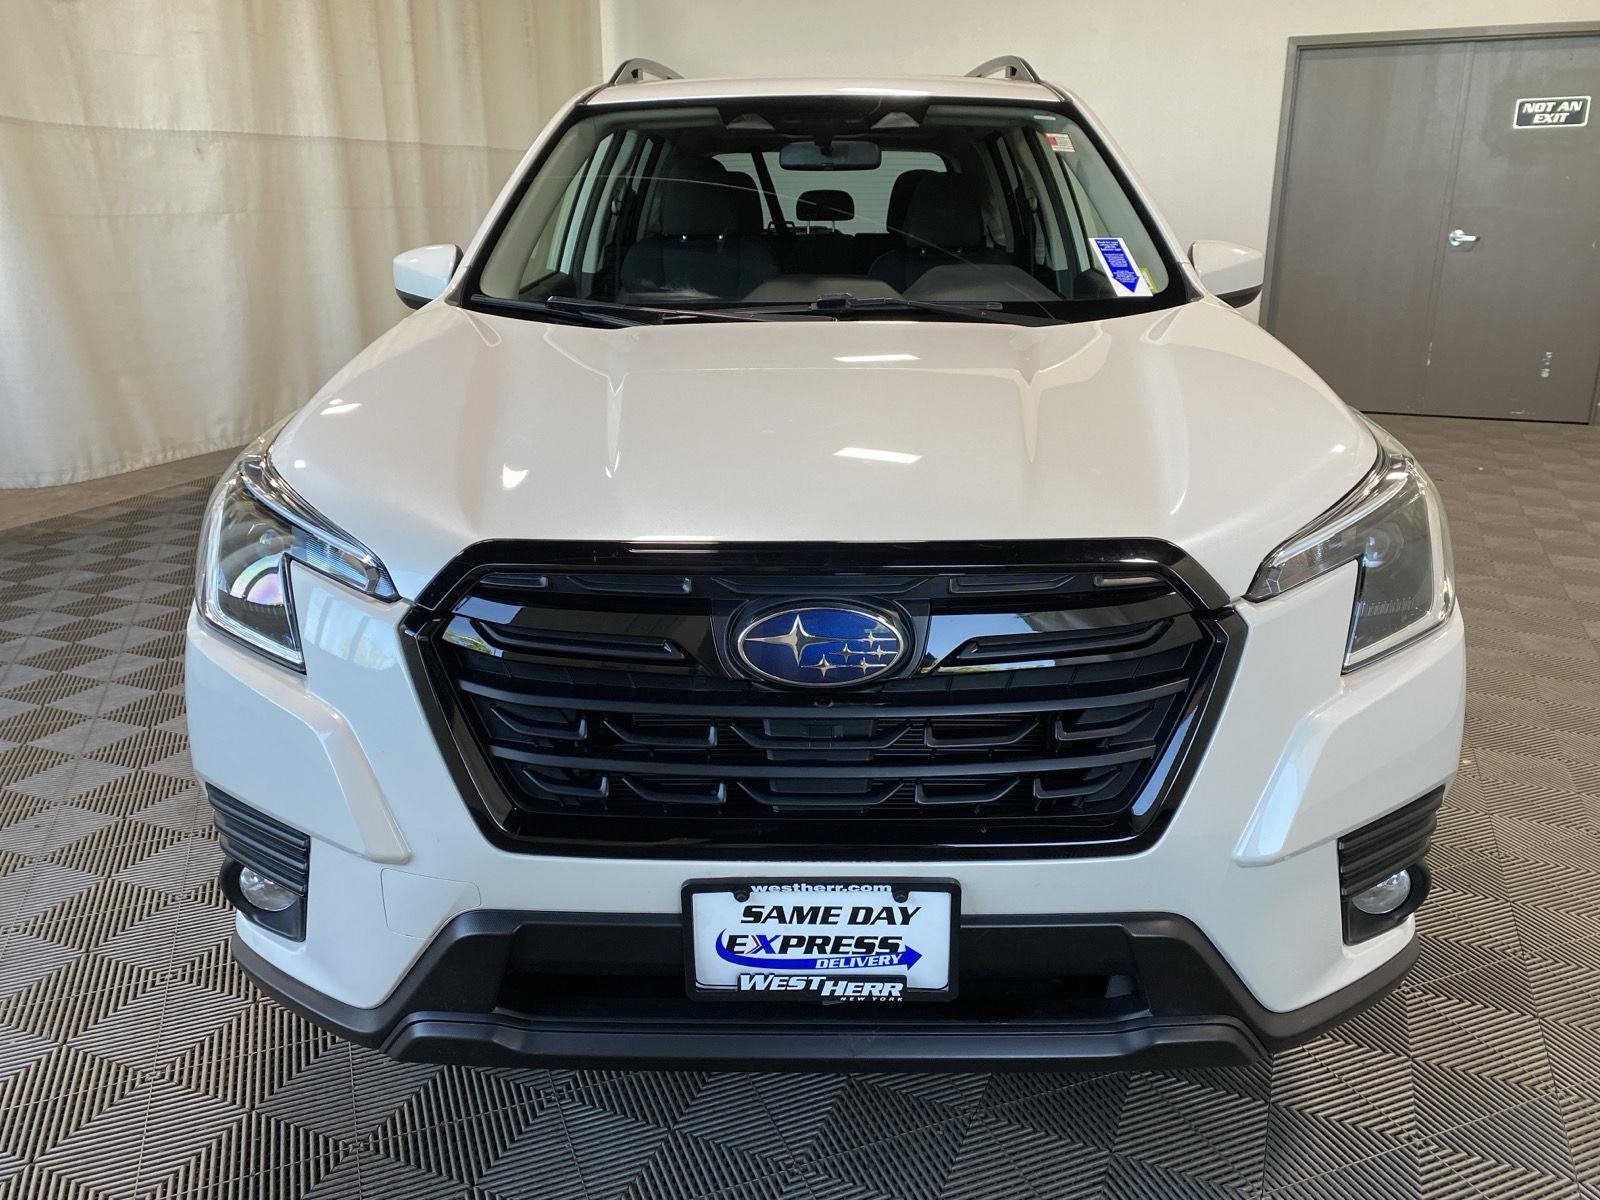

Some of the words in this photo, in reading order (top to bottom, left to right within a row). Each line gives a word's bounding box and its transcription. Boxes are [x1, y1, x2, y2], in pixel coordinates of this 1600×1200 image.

[1522, 102, 1556, 113] NOT
[1556, 101, 1583, 111] AN
[1533, 113, 1570, 123] EXIT
[750, 884, 892, 893] westherr.com
[740, 905, 842, 925] SAME
[848, 906, 922, 926] DAY
[726, 935, 903, 955] EXPRESS
[815, 954, 903, 969] DELIVERY
